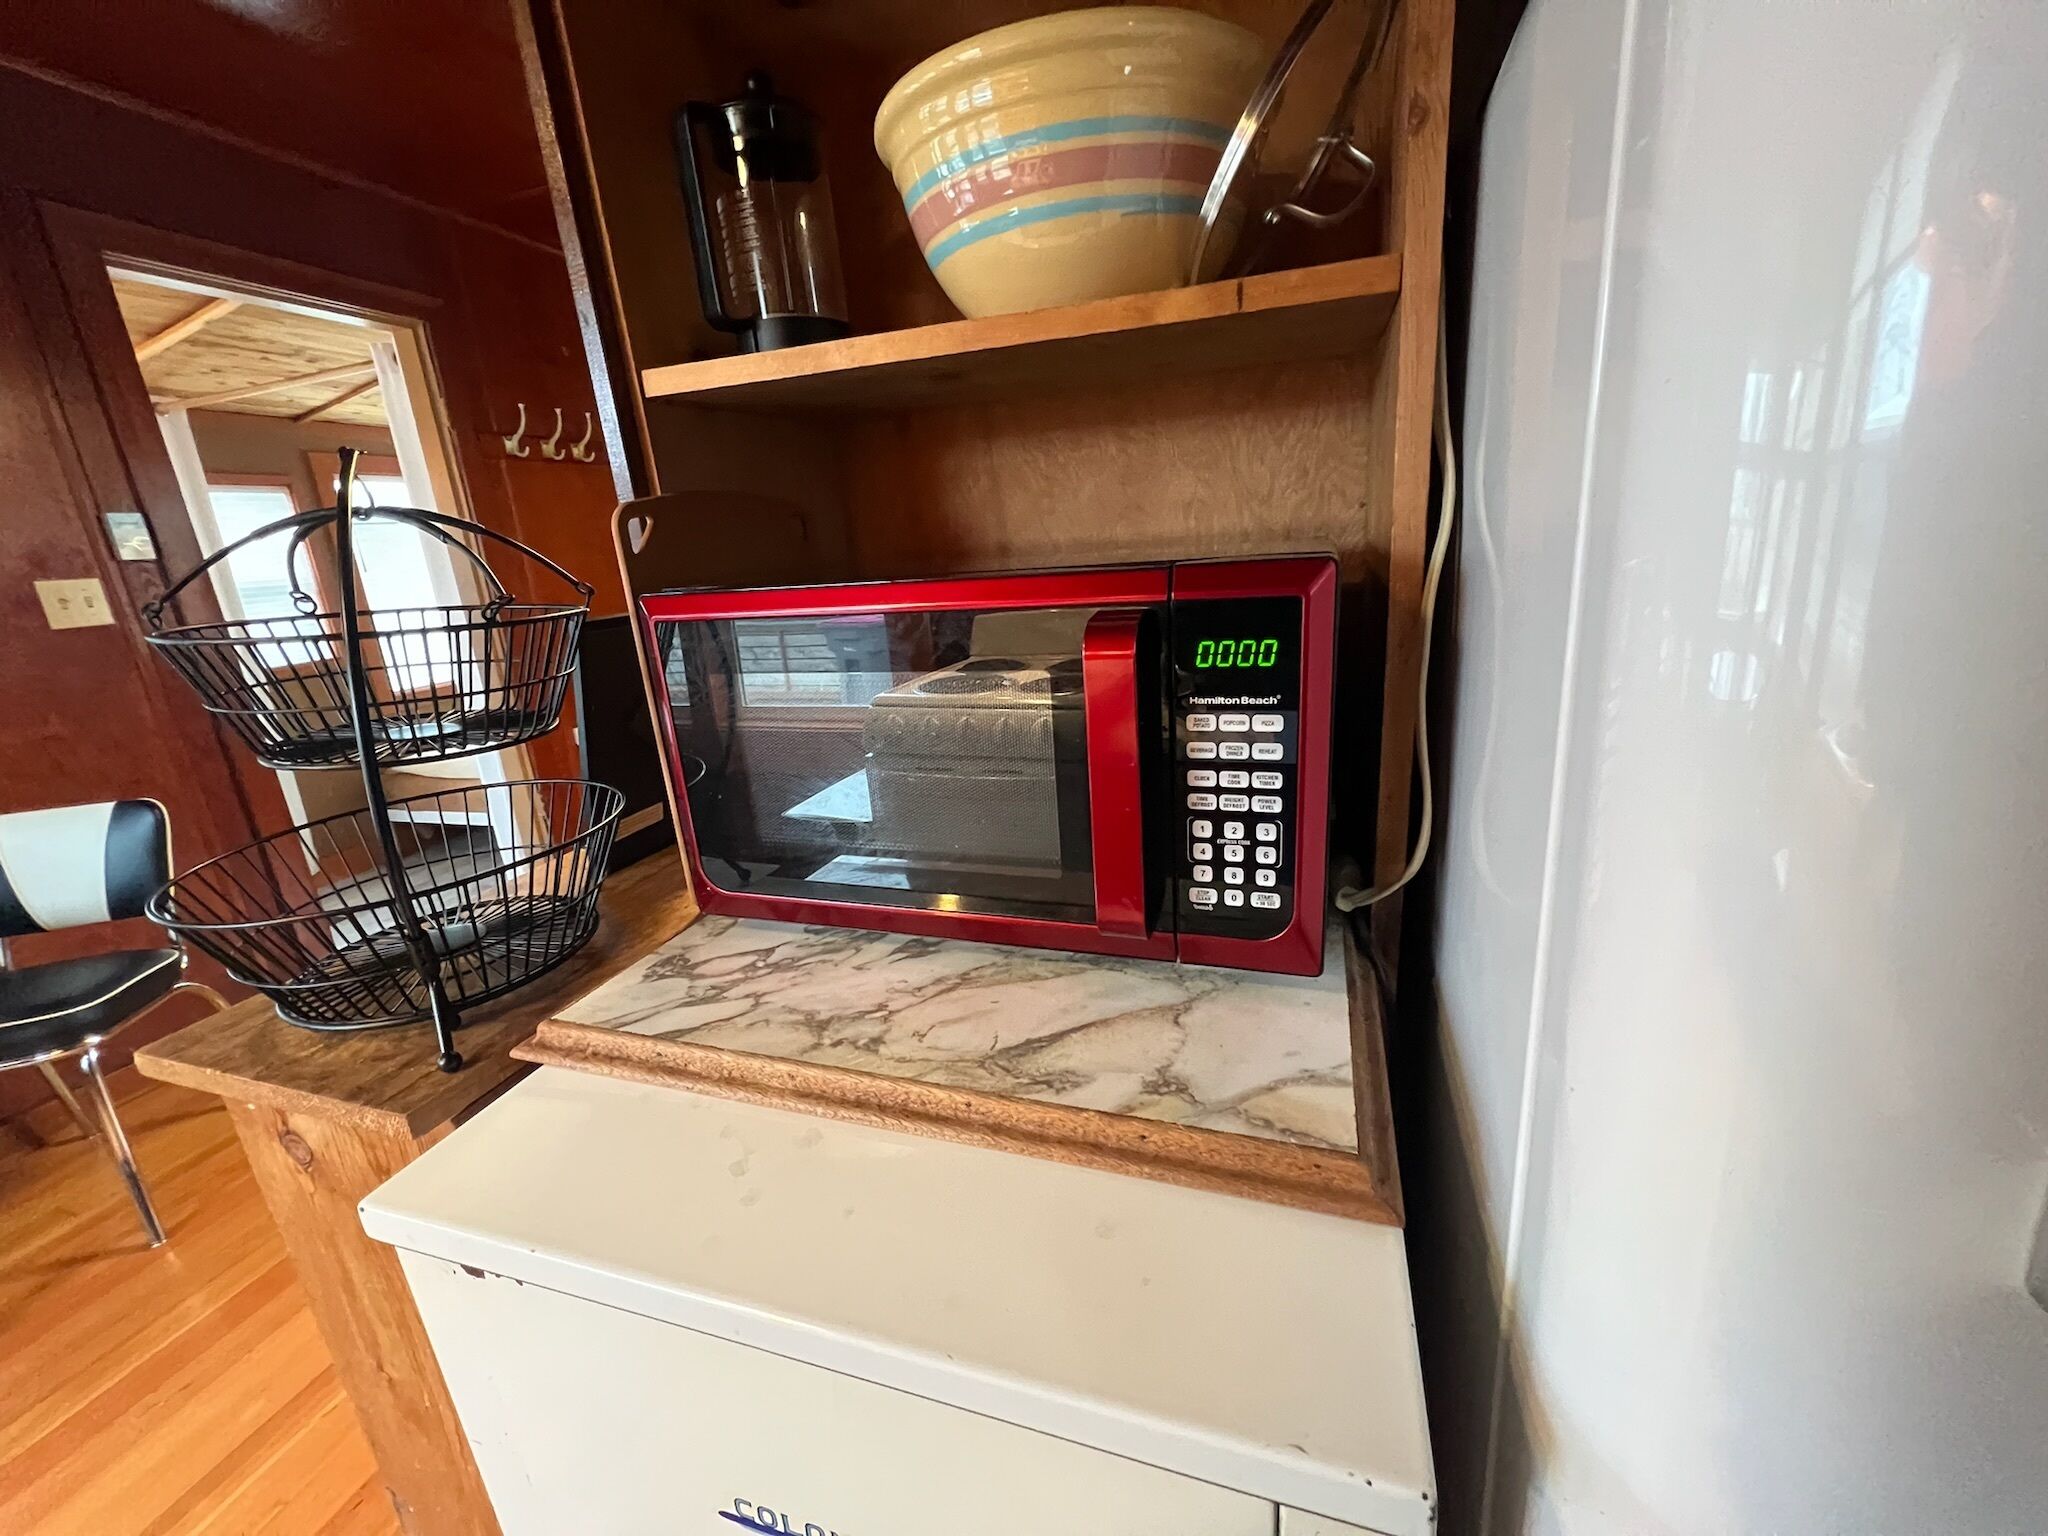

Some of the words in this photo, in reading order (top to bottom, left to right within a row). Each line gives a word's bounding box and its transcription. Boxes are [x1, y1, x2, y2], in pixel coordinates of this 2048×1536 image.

[1195, 639, 1278, 668] 0000
[1189, 696, 1240, 705] Hamilton
[1241, 696, 1277, 705] Beach
[1264, 828, 1270, 836] 3
[1231, 894, 1237, 902] 0
[733, 1497, 842, 1536] COLD
